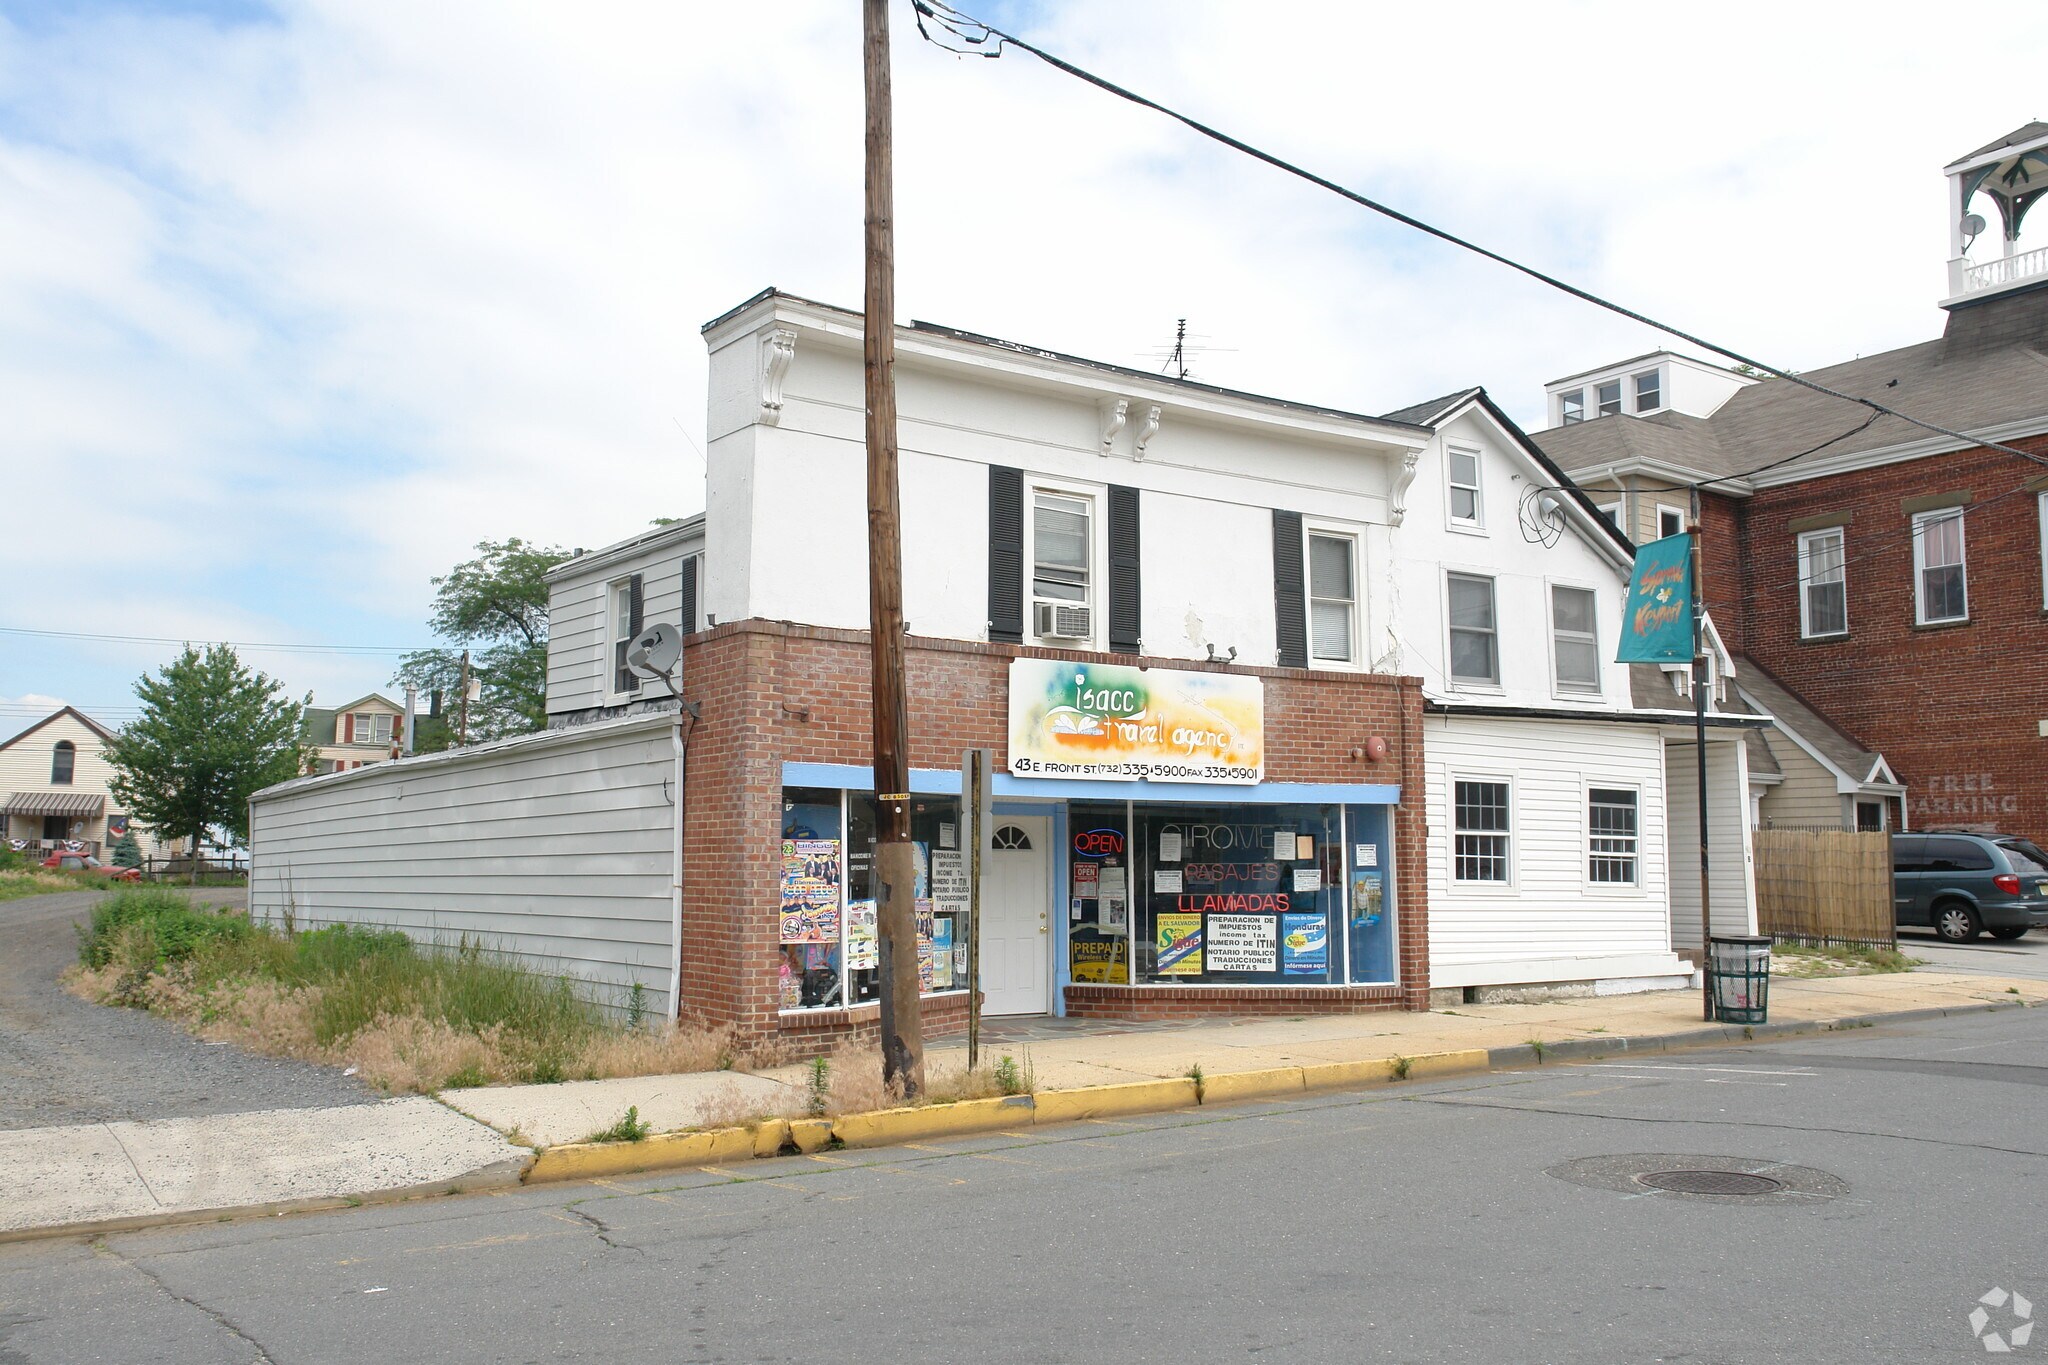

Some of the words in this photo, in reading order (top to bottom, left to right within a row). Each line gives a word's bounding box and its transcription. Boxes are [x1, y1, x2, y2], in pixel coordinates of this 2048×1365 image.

[1075, 674, 1134, 711] isacc
[1104, 713, 1164, 743] travel
[1015, 758, 1031, 771] 43
[1045, 763, 1081, 773] FRONT
[1928, 773, 1994, 792] FREE
[1075, 833, 1123, 853] OPEN
[1077, 868, 1096, 876] OPEN
[1185, 863, 1278, 881] PASAJES
[1178, 894, 1290, 912] LLAMADAS
[1074, 942, 1123, 953] PREPAD
[1256, 939, 1275, 948] ITIN
